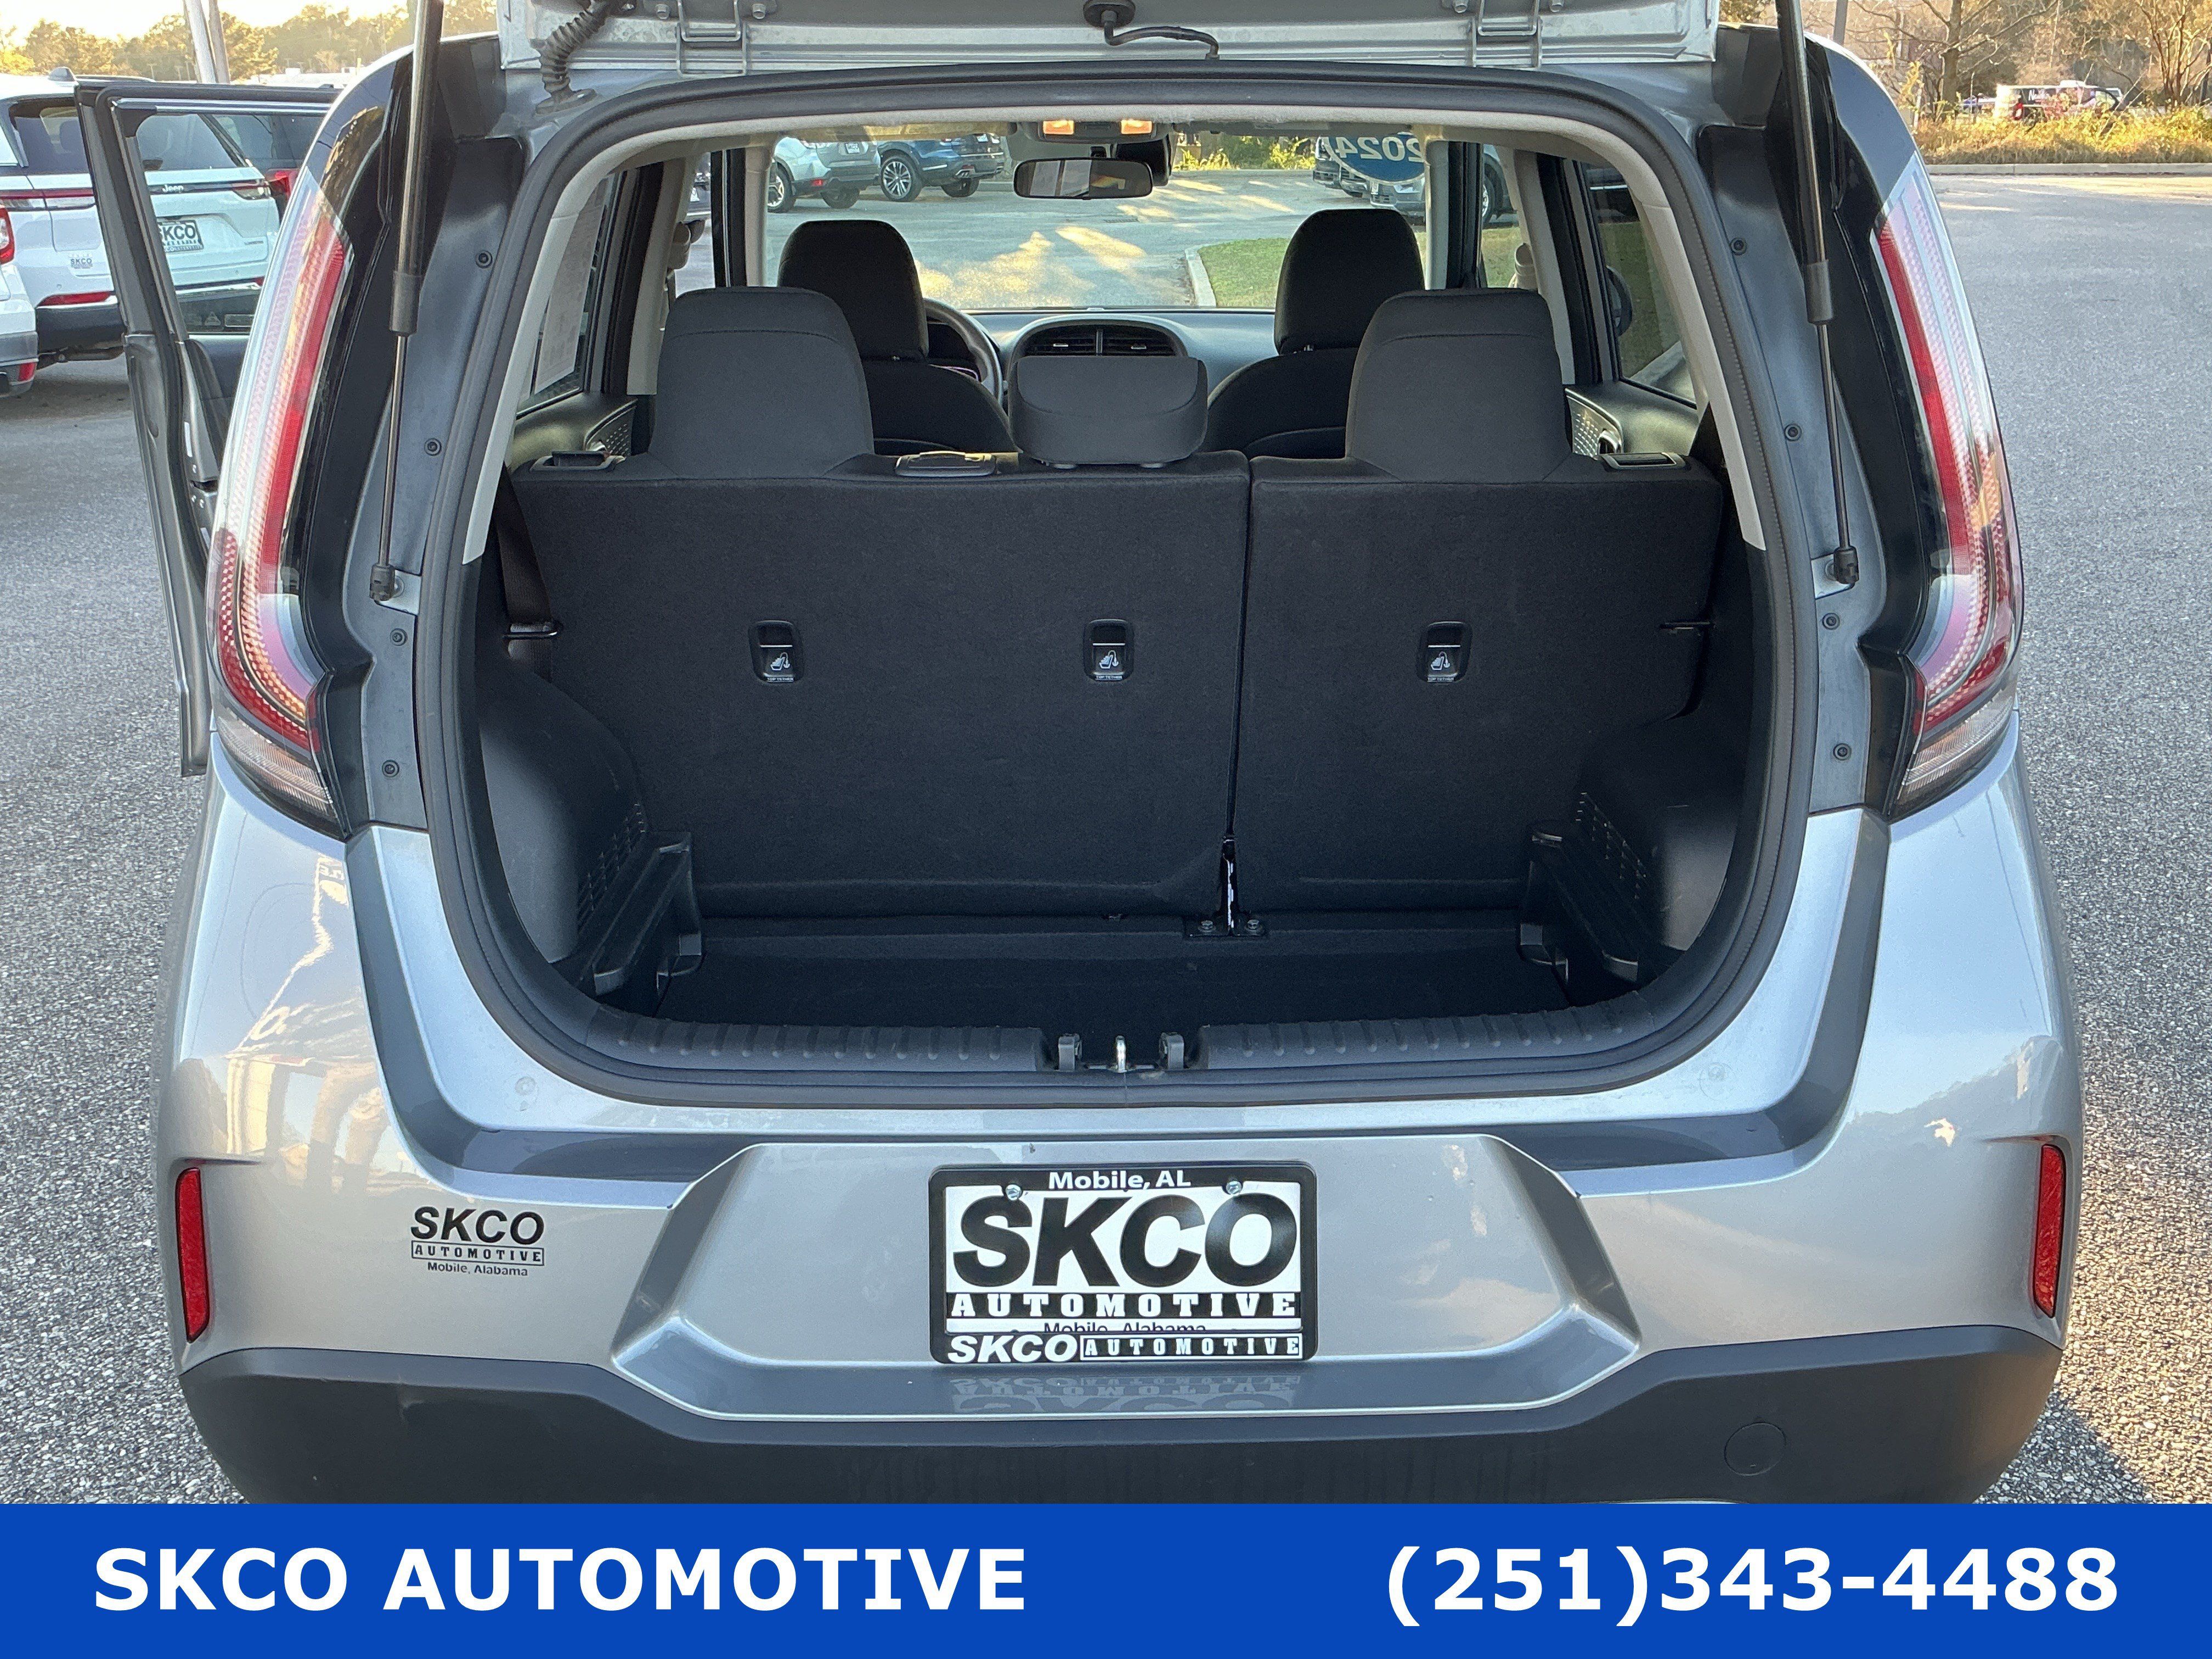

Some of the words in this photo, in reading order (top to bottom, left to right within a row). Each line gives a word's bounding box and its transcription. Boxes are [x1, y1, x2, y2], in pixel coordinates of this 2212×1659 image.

[162, 184, 184, 193] Jeep
[1048, 1170, 1150, 1190] Mobile,
[1155, 1170, 1191, 1187] AL
[410, 1206, 544, 1245] SKCO
[953, 1193, 1297, 1287] SKCO
[415, 1244, 541, 1262] AUTOMOTIVE
[427, 1262, 471, 1274] Mobile,
[474, 1264, 528, 1276] Alabama
[951, 1293, 1295, 1317] AUTOMOTIVE
[947, 1334, 1077, 1363] SKCO
[1085, 1337, 1300, 1357] AUTOMOTIVE
